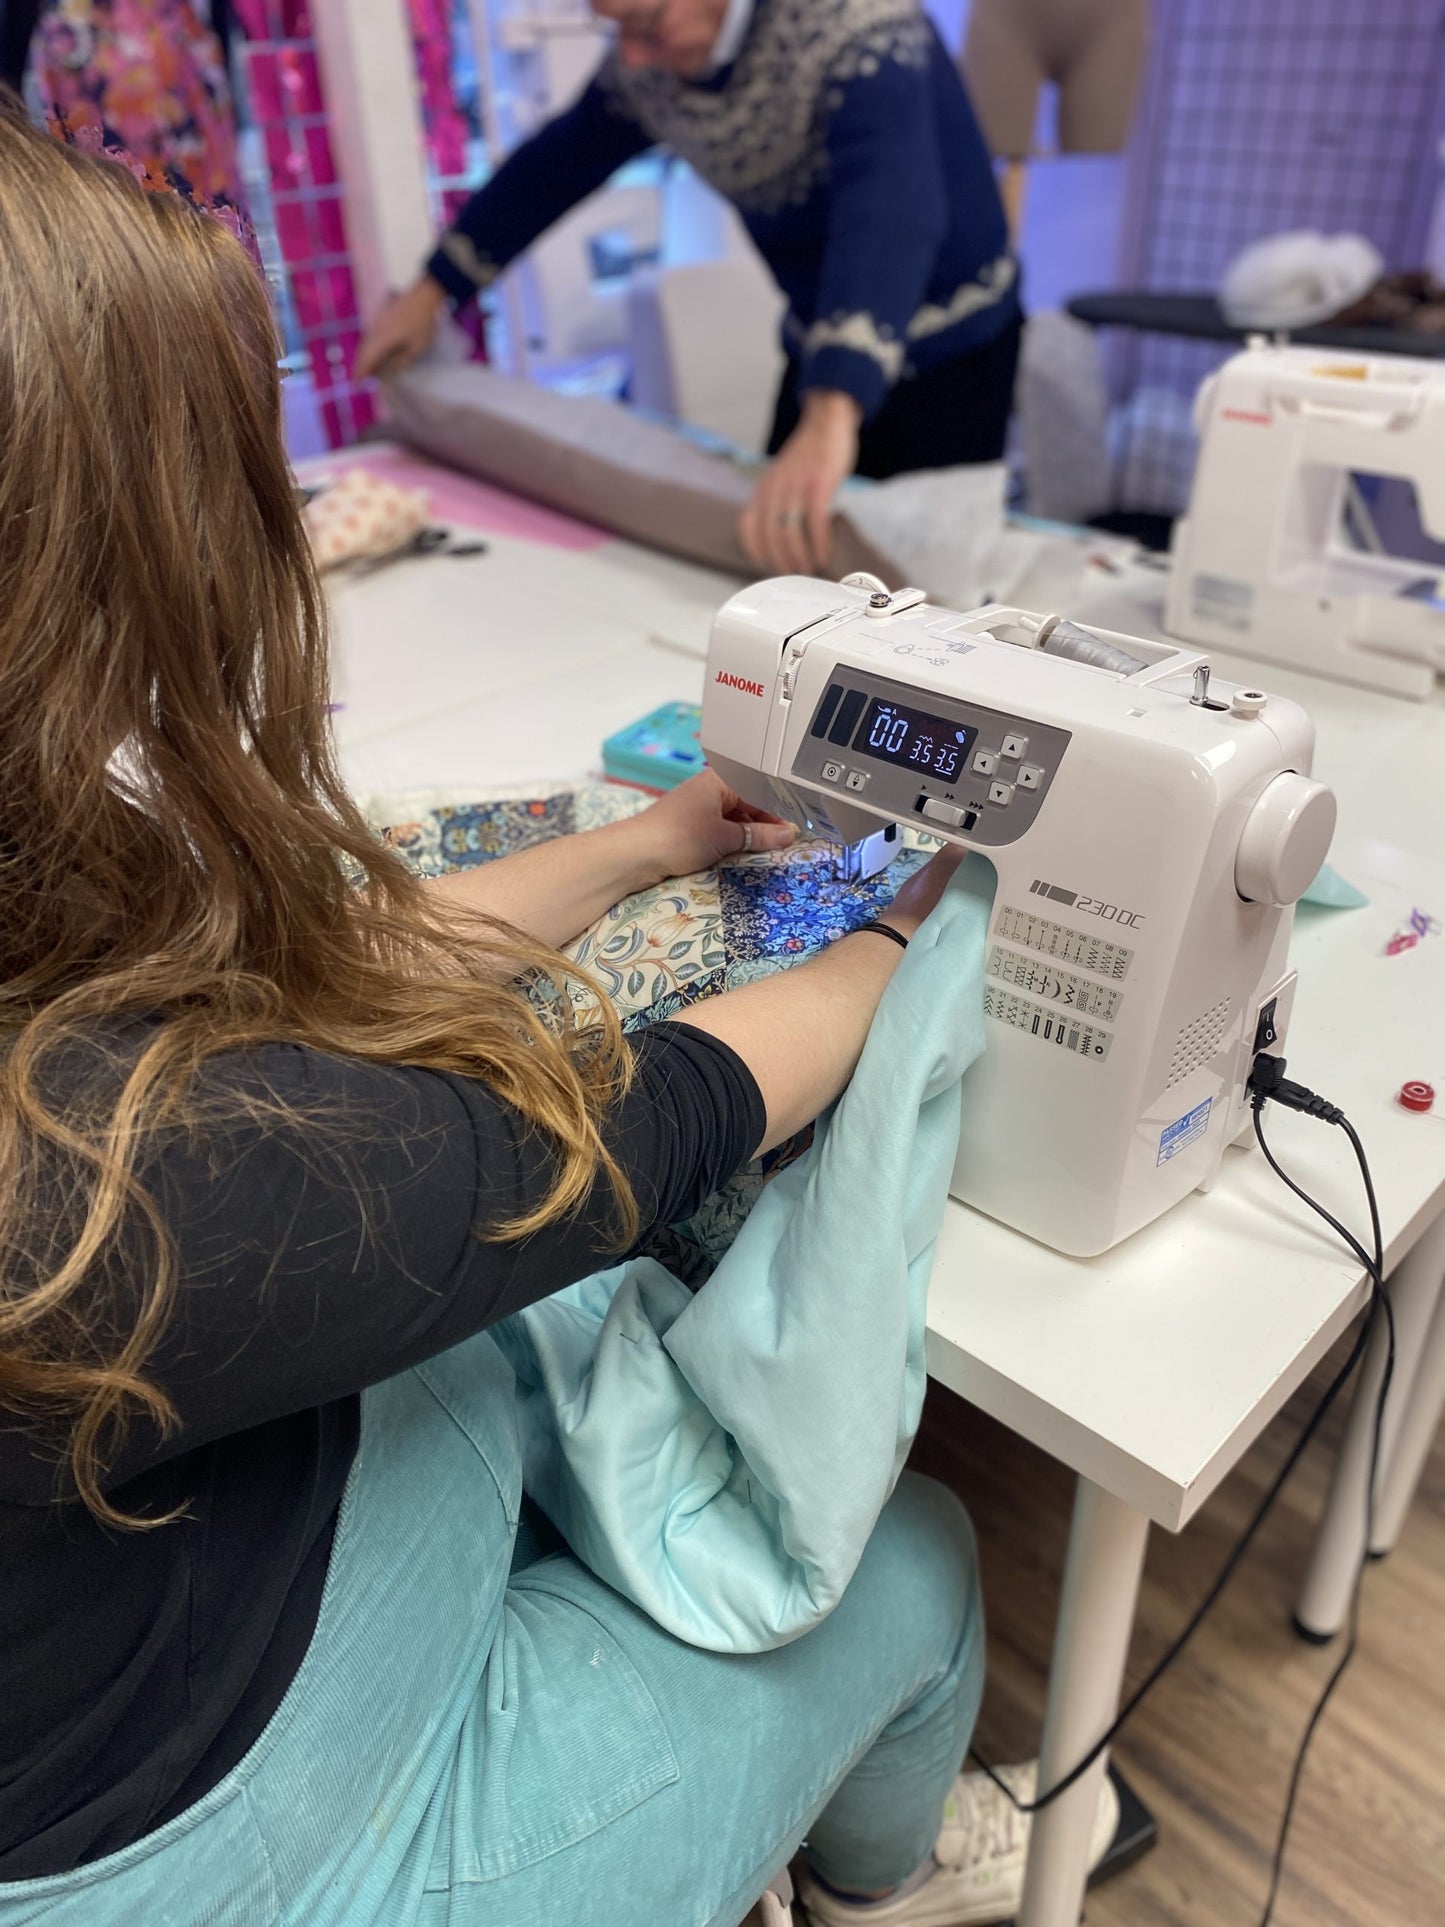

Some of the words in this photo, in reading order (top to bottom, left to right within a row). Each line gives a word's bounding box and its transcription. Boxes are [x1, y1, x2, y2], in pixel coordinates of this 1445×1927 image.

[715, 671, 765, 697] JANOME
[869, 714, 909, 753] 00
[909, 740, 933, 763] 3.5
[933, 748, 958, 771] 3.5
[1005, 907, 1012, 915] 00
[1016, 911, 1024, 919] 01
[1029, 916, 1037, 924] 02
[1041, 920, 1049, 928] 03
[1066, 930, 1074, 938] 05
[1079, 934, 1087, 942] 06
[1105, 943, 1114, 952] 08
[1119, 948, 1128, 957] 09
[1032, 962, 1040, 970] 13
[1045, 966, 1052, 974] 14
[1057, 971, 1065, 979] 15
[1070, 976, 1077, 984] 16
[1096, 986, 1104, 994] 18
[1109, 991, 1117, 999] 19
[1034, 1006, 1042, 1014] 24
[1072, 1021, 1080, 1029] 27
[1085, 1026, 1093, 1034] 28
[1097, 1031, 1106, 1039] 29
